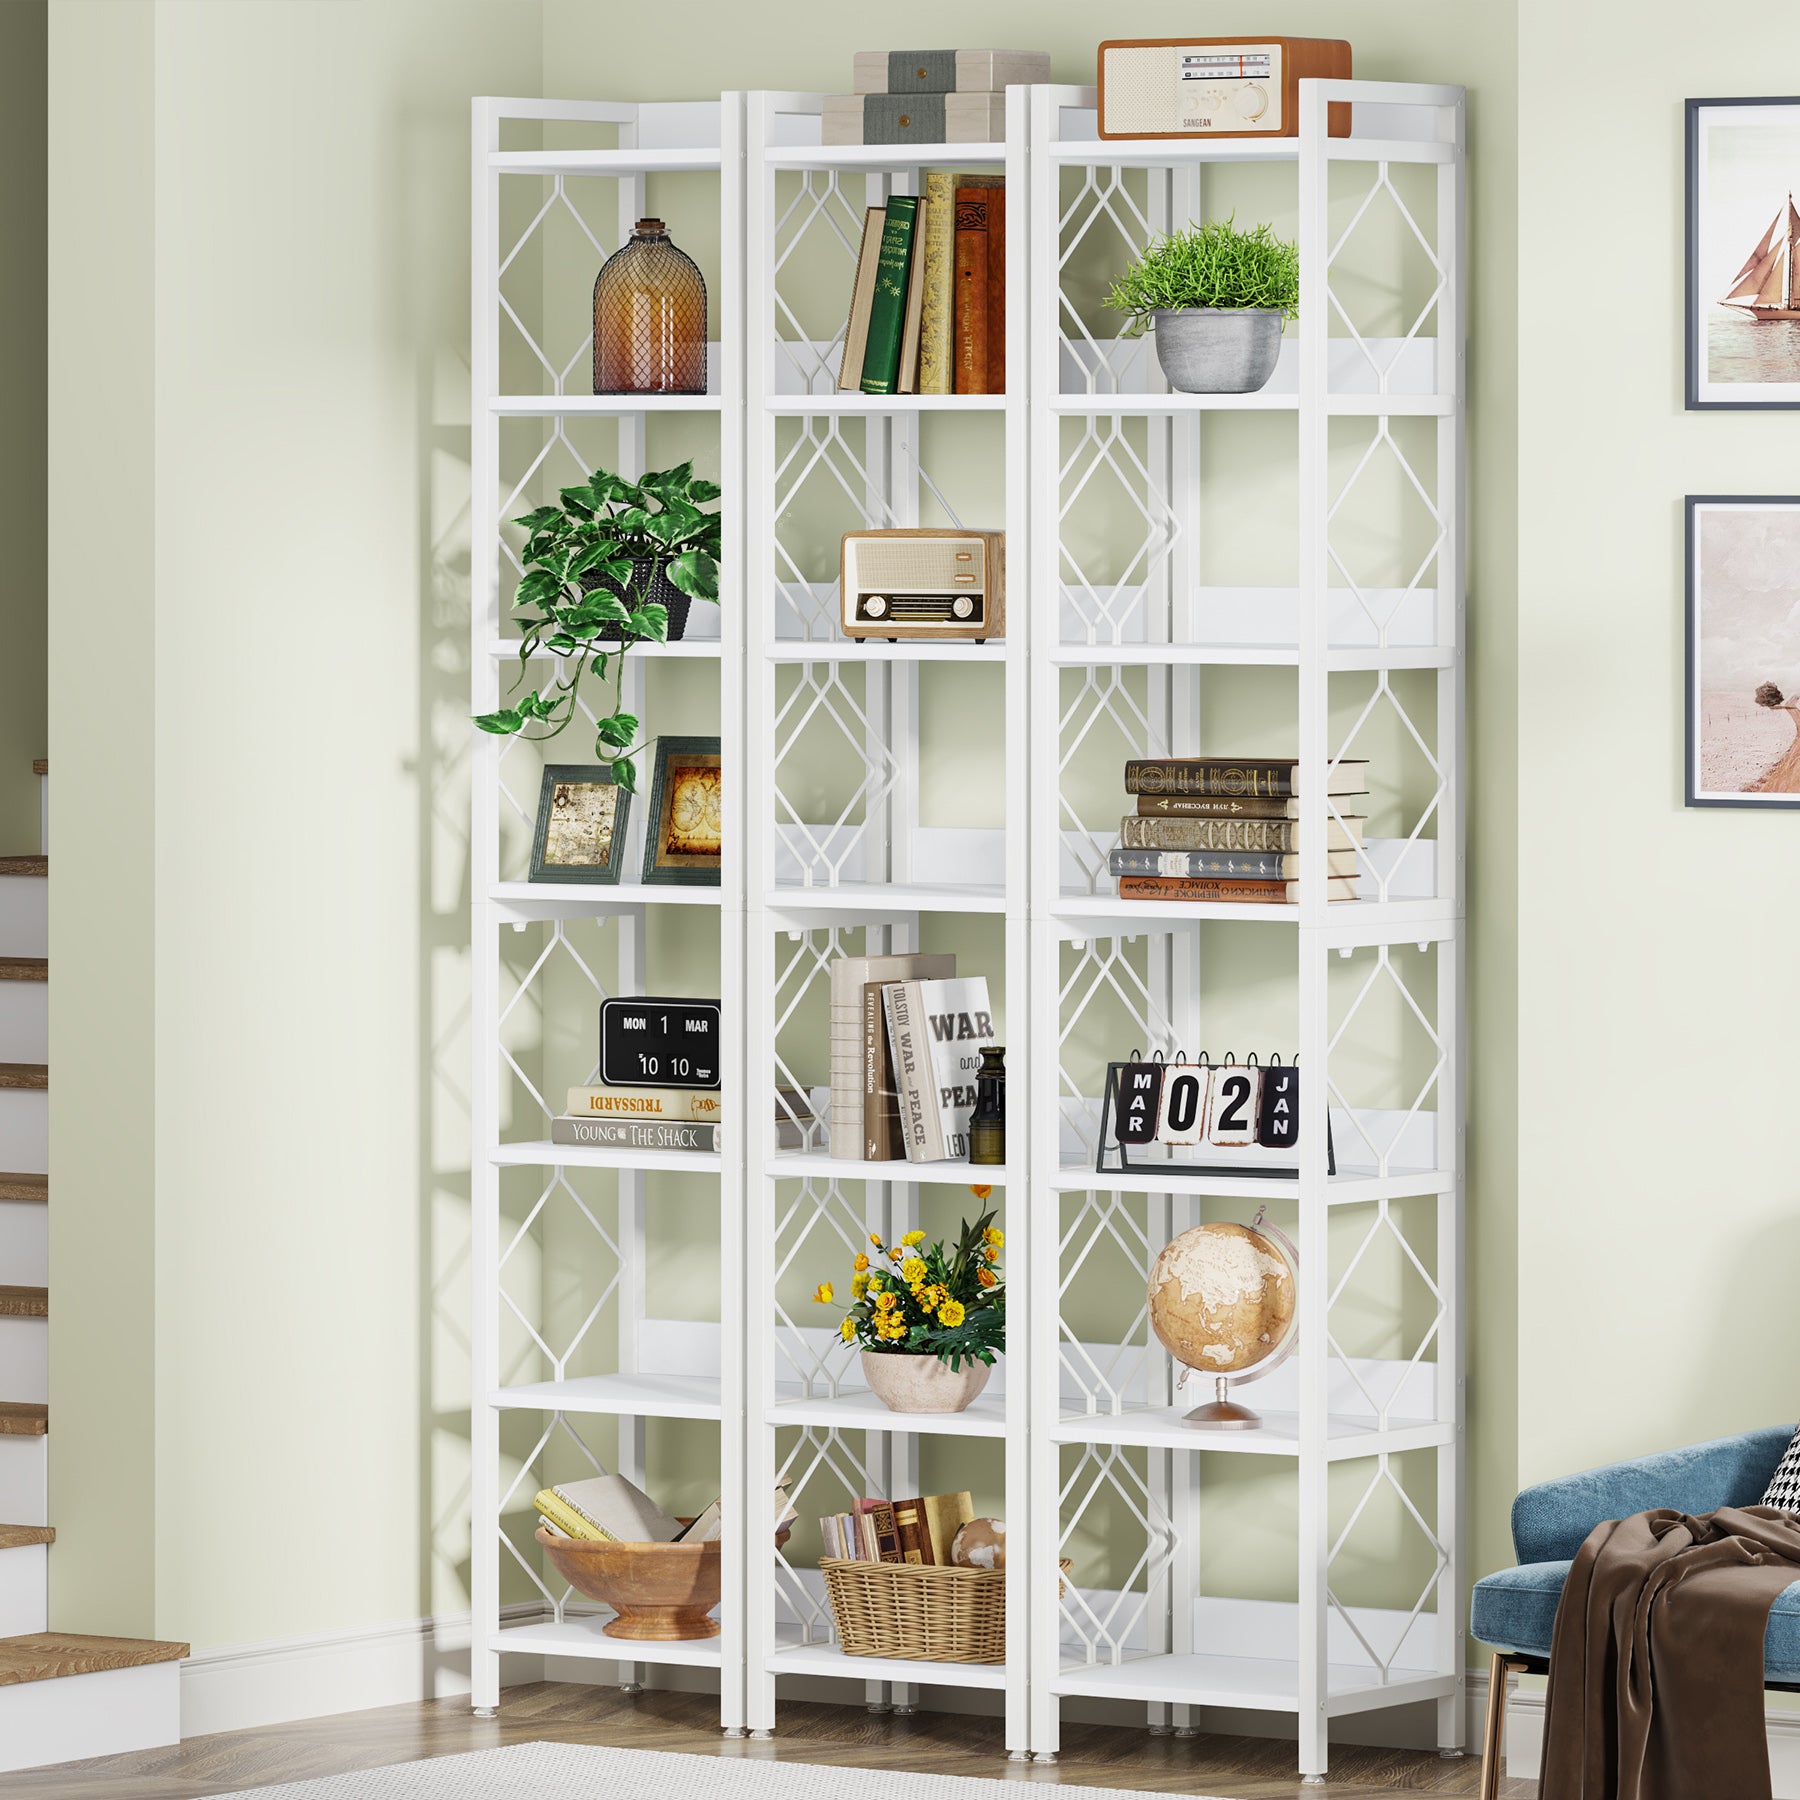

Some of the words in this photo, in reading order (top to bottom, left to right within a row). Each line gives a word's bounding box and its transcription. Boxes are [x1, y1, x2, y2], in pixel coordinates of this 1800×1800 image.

[1183, 118, 1212, 128] SANGEAN
[1174, 889, 1220, 899] ШЕРЛОКЕ
[1179, 880, 1221, 890] ХОЛМСЕ
[1229, 887, 1279, 897] ЗАПИСКИ
[867, 992, 875, 1034] REVEALING
[893, 987, 910, 1026] TOLSTOY
[623, 1017, 647, 1031] MON
[660, 1016, 668, 1034] 1
[685, 1020, 709, 1032] MAR
[929, 1011, 994, 1042] WAR
[900, 1031, 916, 1074] WAR
[960, 1055, 980, 1070] and
[640, 1056, 659, 1075] 10
[671, 1058, 690, 1076] 10
[867, 1047, 876, 1094] Revolution
[590, 1096, 662, 1113] TRUSSARDI
[940, 1085, 977, 1109] PEA
[908, 1089, 926, 1146] PEACE
[572, 1123, 618, 1141] YOUNG
[629, 1125, 654, 1146] THE
[657, 1125, 698, 1147] SHACK
[946, 1134, 967, 1158] LEO
[550, 1510, 576, 1533] MOSSMAN
